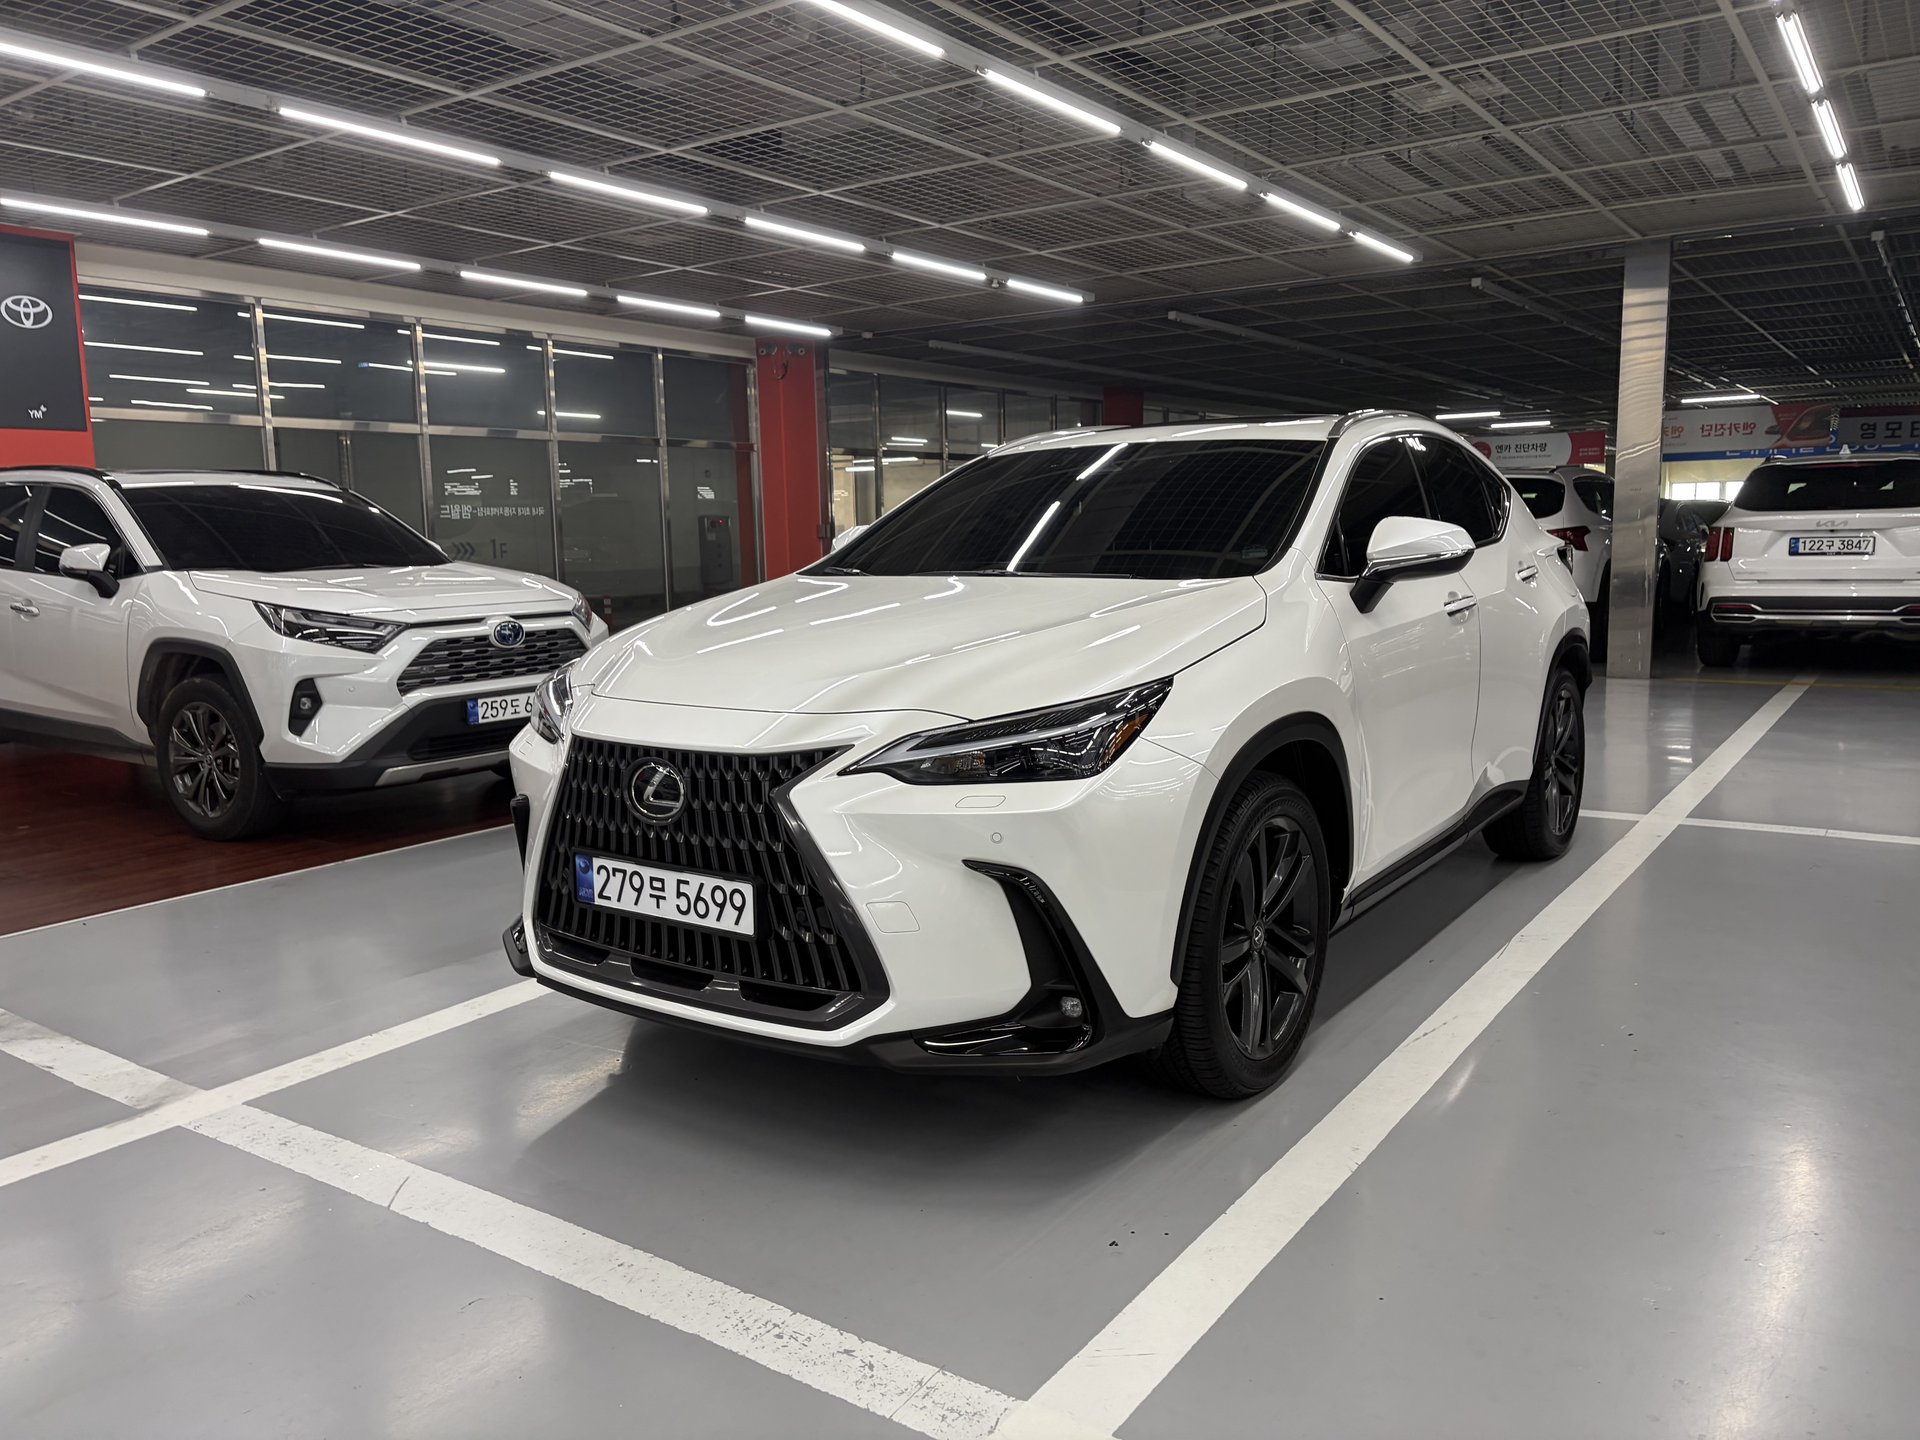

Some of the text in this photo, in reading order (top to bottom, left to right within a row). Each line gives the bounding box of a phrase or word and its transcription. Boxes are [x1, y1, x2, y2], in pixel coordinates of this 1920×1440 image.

[28, 409, 43, 419] YM
[1495, 444, 1511, 453] 엔카
[1514, 442, 1547, 453] 진단차량
[1801, 539, 1871, 551] 122구 3847
[481, 698, 521, 720] 259도
[596, 864, 747, 926] 279무 5699
